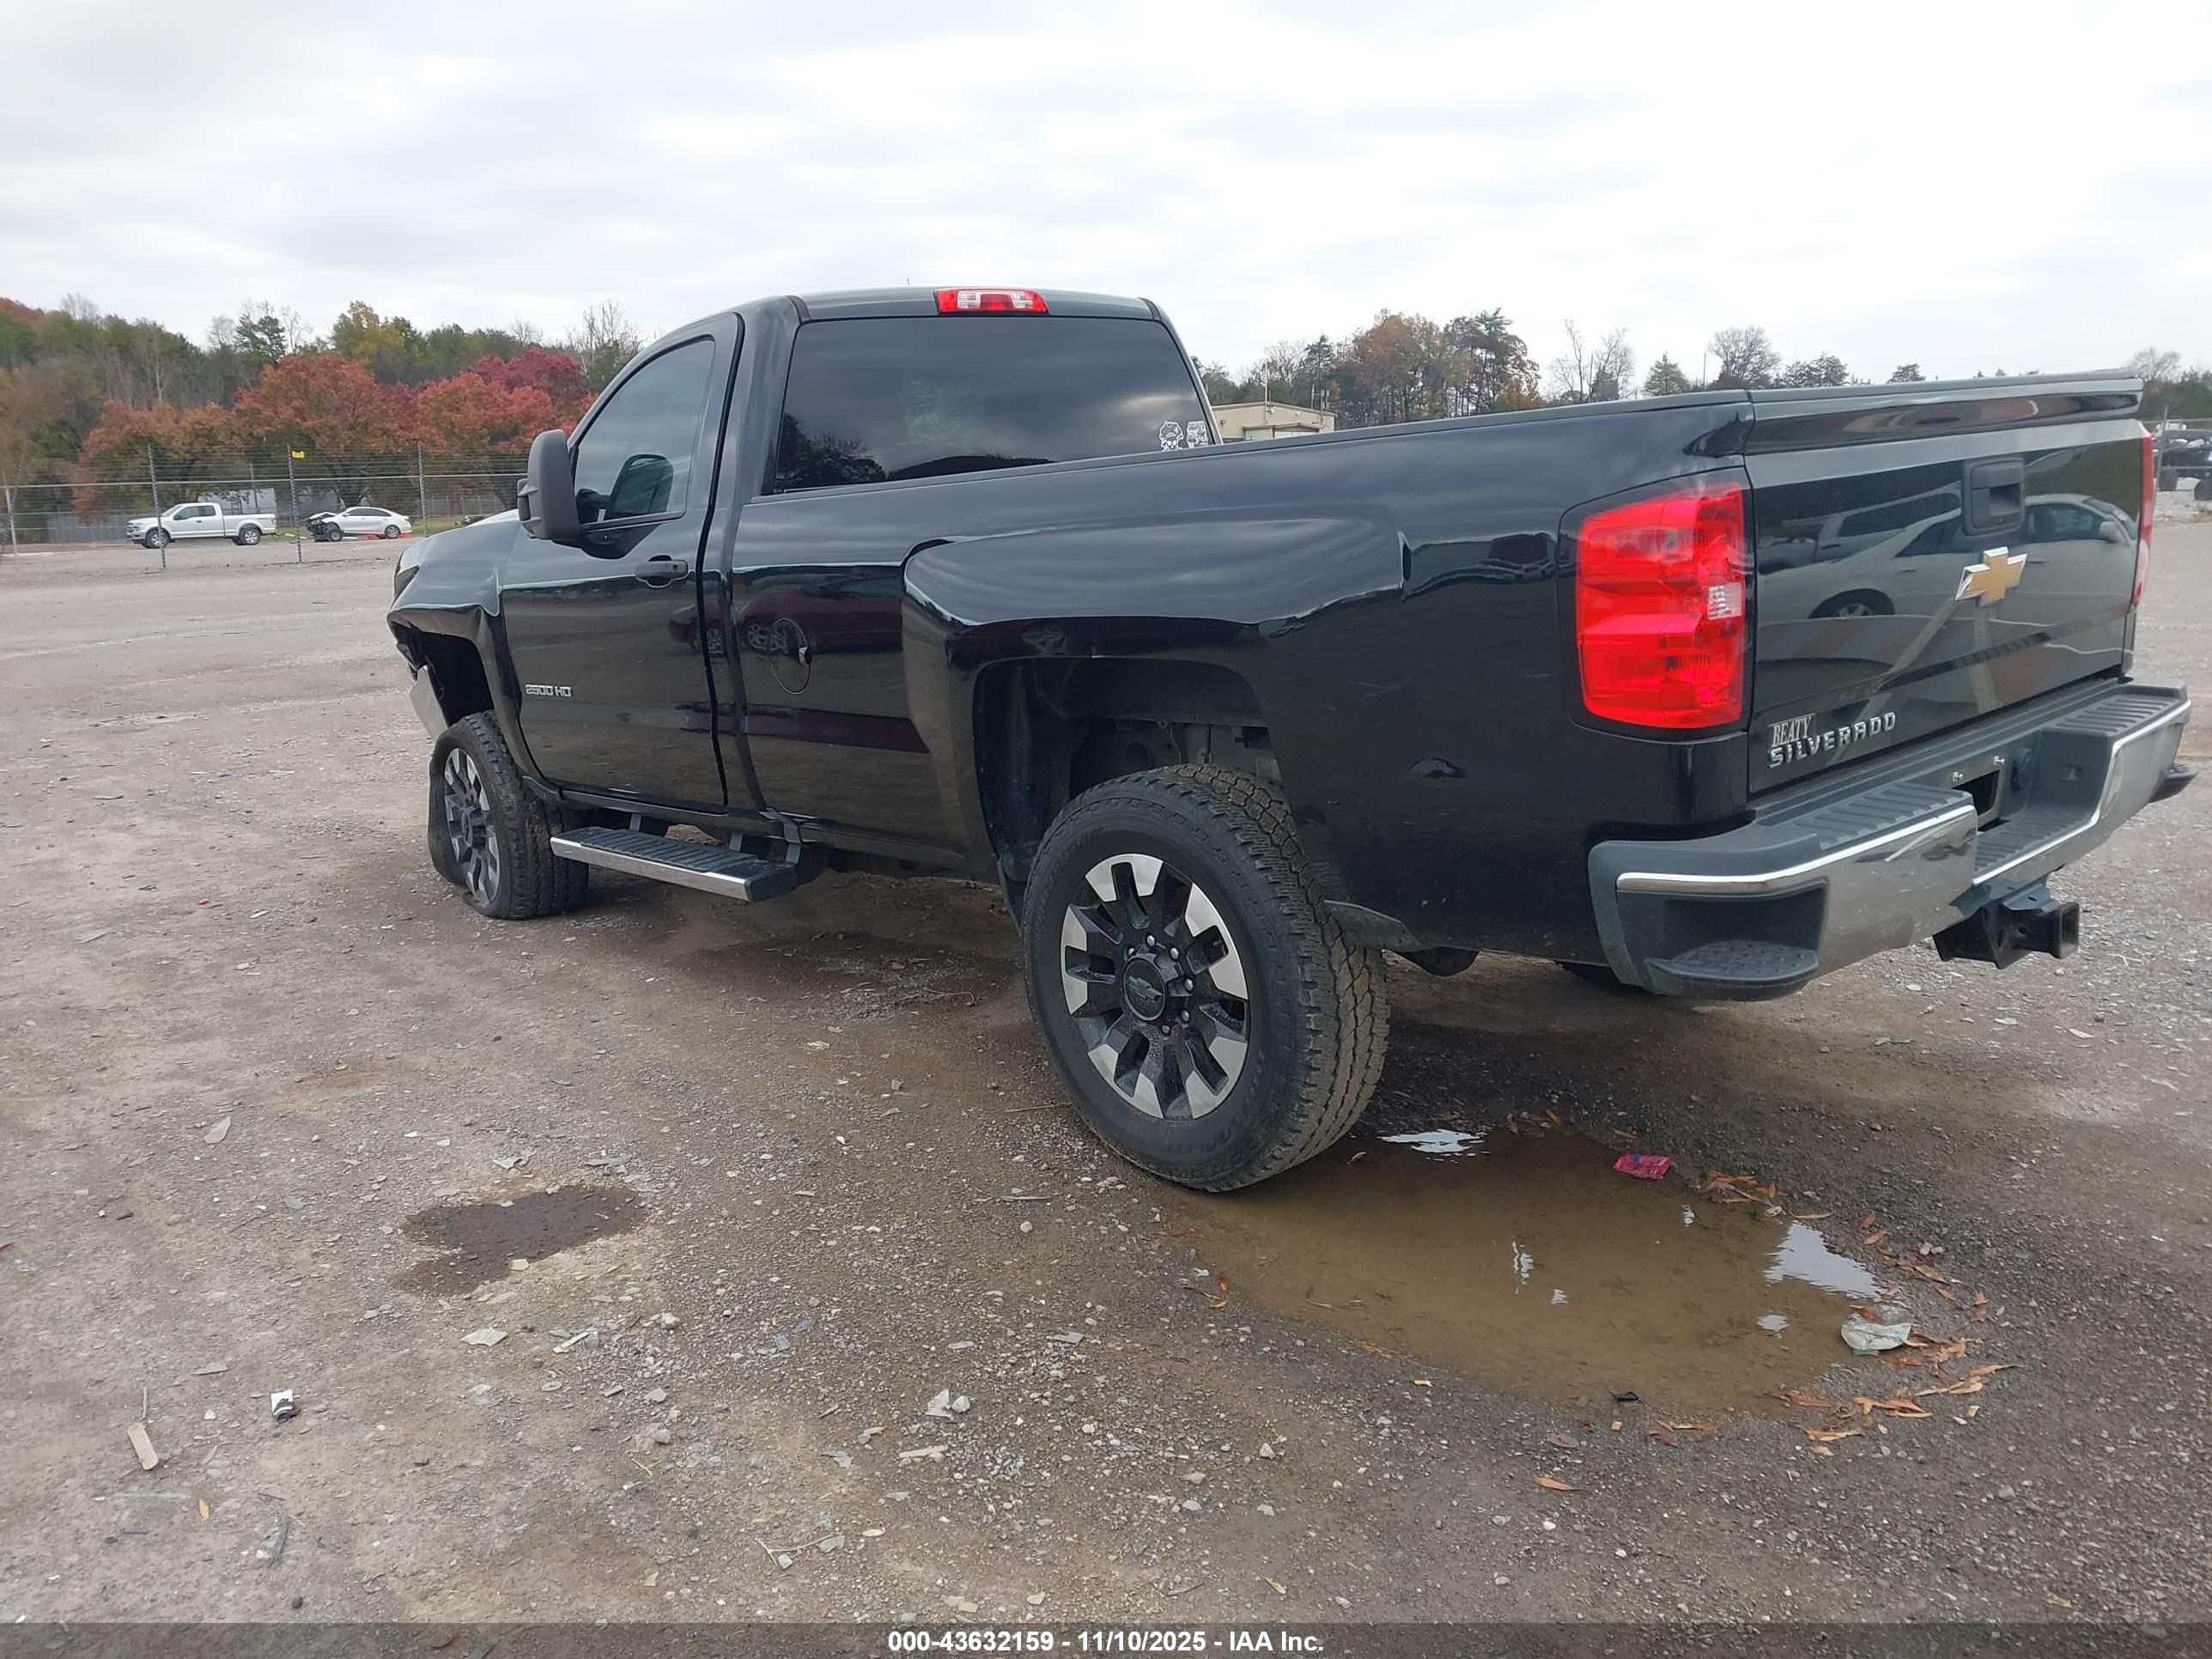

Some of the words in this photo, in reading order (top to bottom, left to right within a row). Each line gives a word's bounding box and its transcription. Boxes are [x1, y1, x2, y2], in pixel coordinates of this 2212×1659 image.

[525, 684, 554, 696] 2500
[555, 686, 572, 697] HD
[1769, 712, 1897, 769] SILVERADO
[1771, 714, 1814, 748] BEATY
